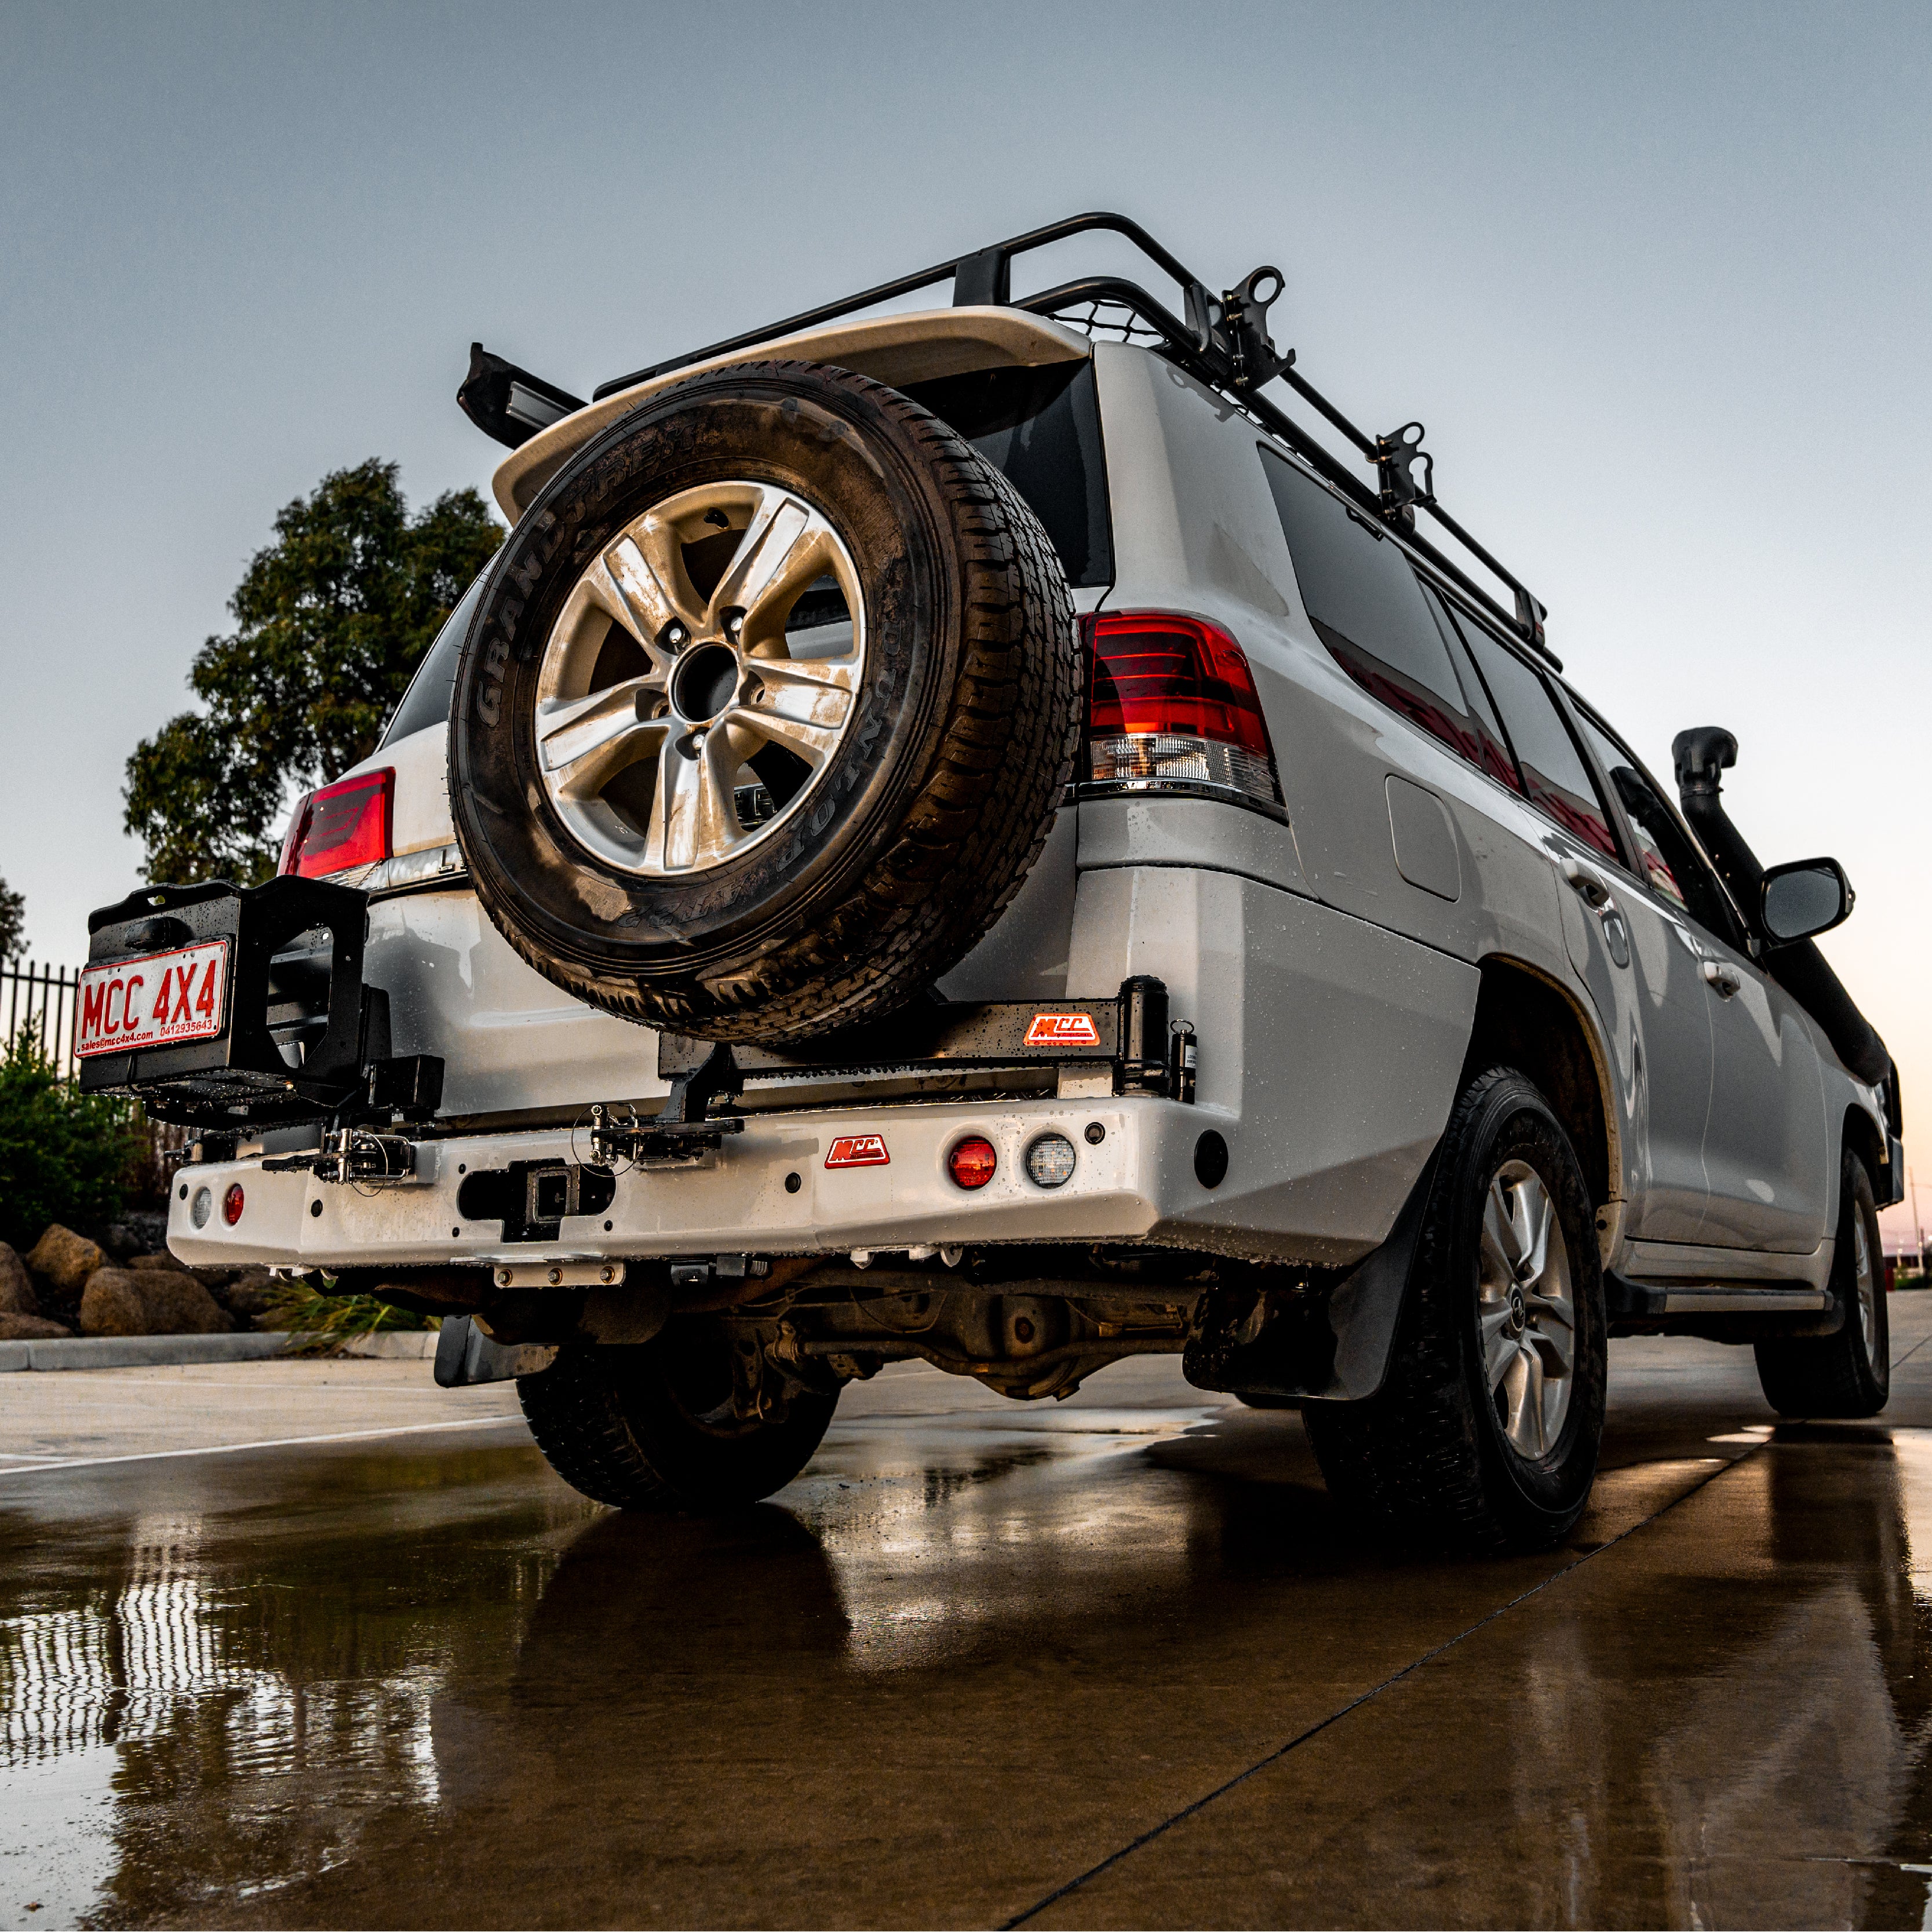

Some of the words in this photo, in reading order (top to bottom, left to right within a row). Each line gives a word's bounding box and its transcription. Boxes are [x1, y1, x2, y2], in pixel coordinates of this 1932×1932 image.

[776, 618, 902, 872] DUNLOP
[81, 975, 144, 1040] MCC
[152, 960, 217, 1025] 4X4
[160, 1019, 212, 1037] 0412935643
[1030, 1018, 1091, 1037] MCC
[81, 1030, 153, 1052] sales@mcc4x4.com
[829, 1139, 882, 1161] MCC
